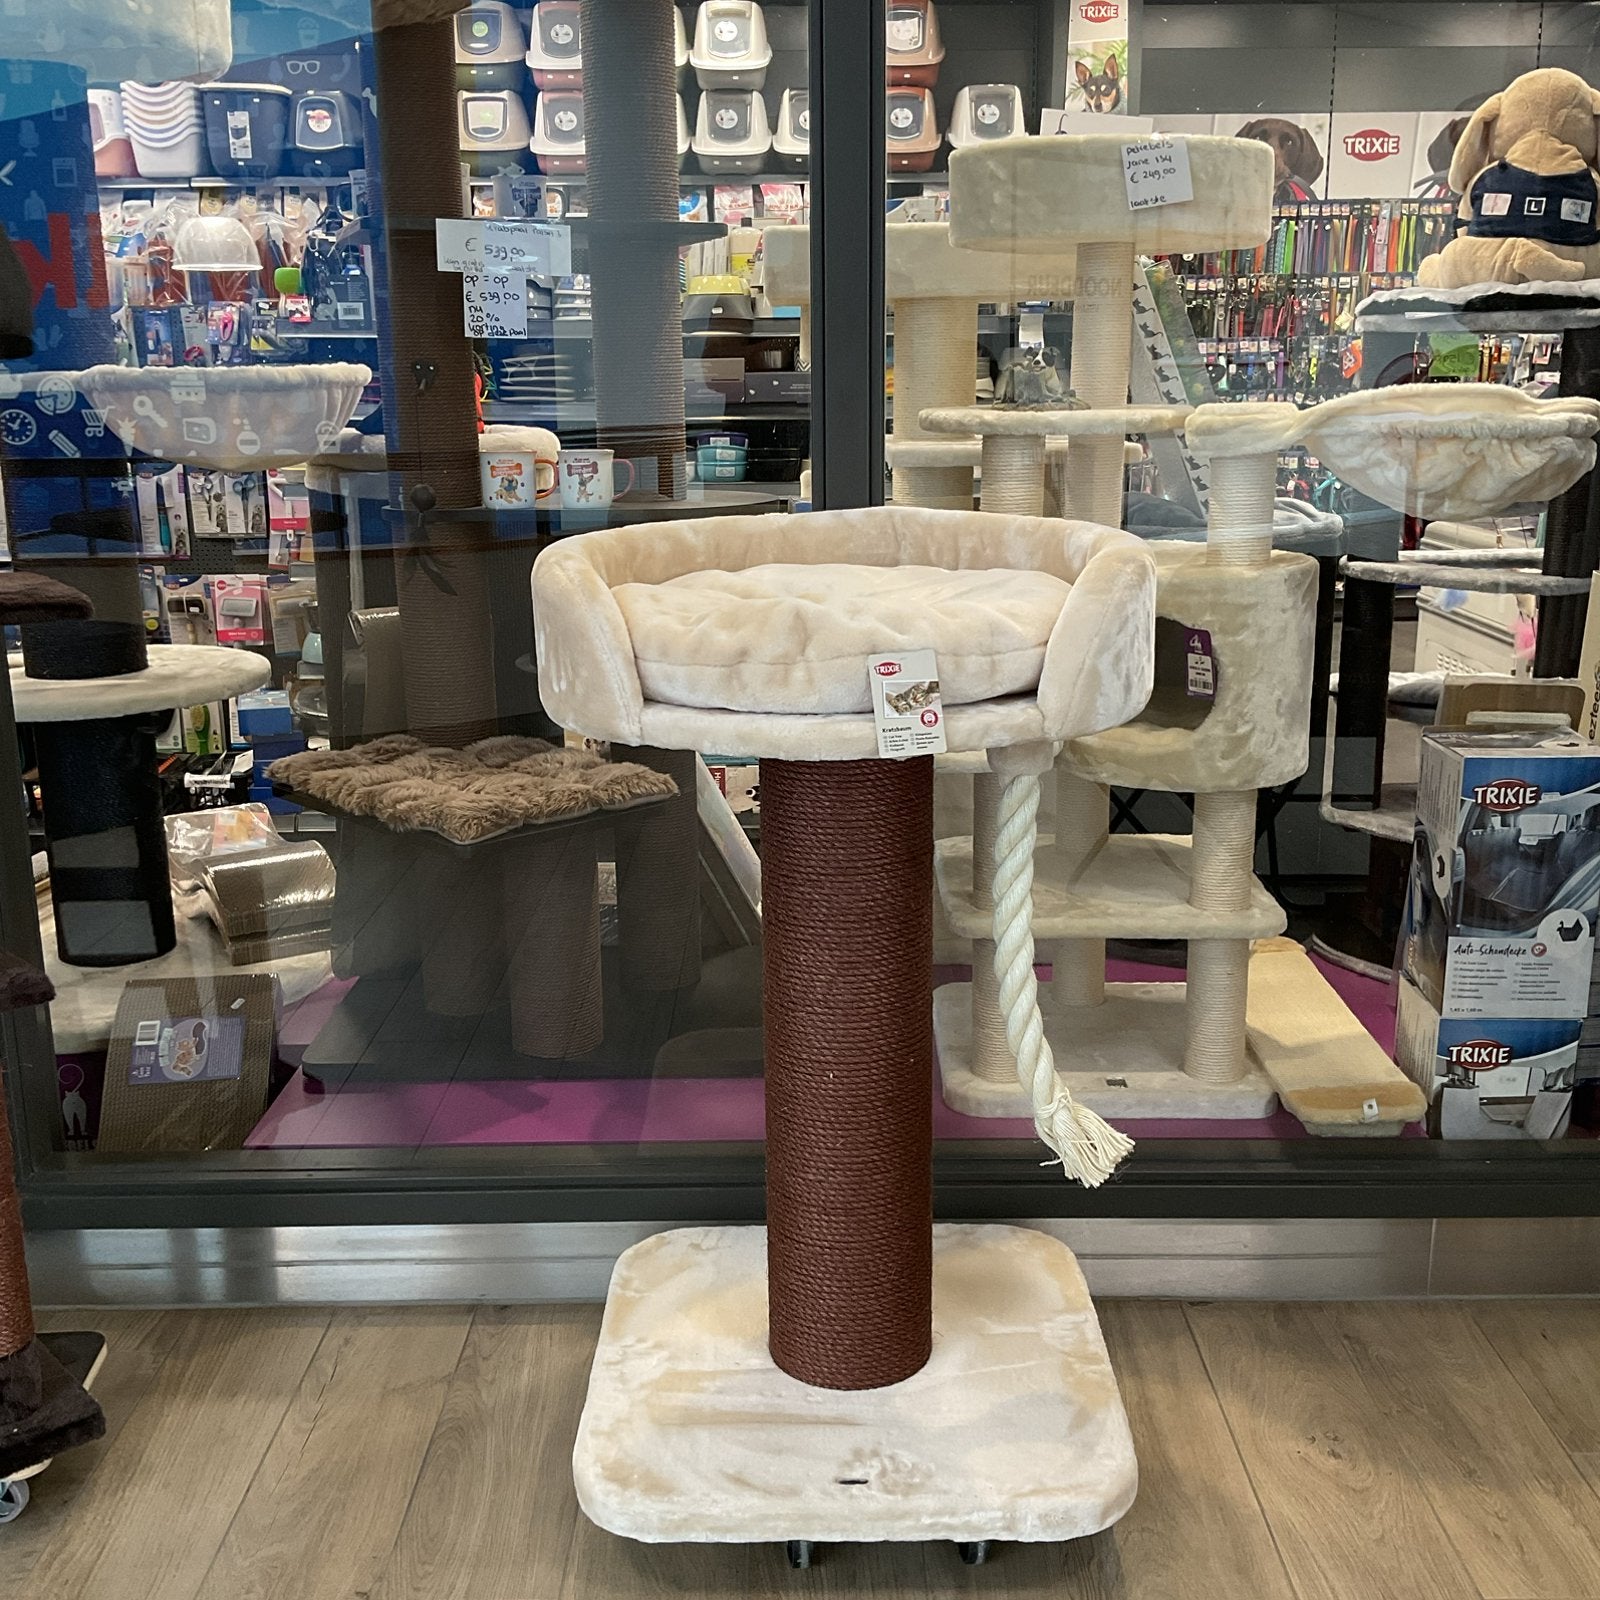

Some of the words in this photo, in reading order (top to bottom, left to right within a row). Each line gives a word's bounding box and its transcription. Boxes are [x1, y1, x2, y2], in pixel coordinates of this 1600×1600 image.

[1130, 171, 1140, 184] €
[1142, 167, 1177, 181] 249,00
[465, 237, 478, 252] €
[484, 244, 526, 262] 539,00
[464, 275, 479, 287] op
[493, 276, 509, 288] op
[465, 291, 476, 303] €
[479, 291, 520, 305] 539,00
[1473, 786, 1538, 805] TRIXIE
[1448, 1046, 1511, 1064] TRIXIE
